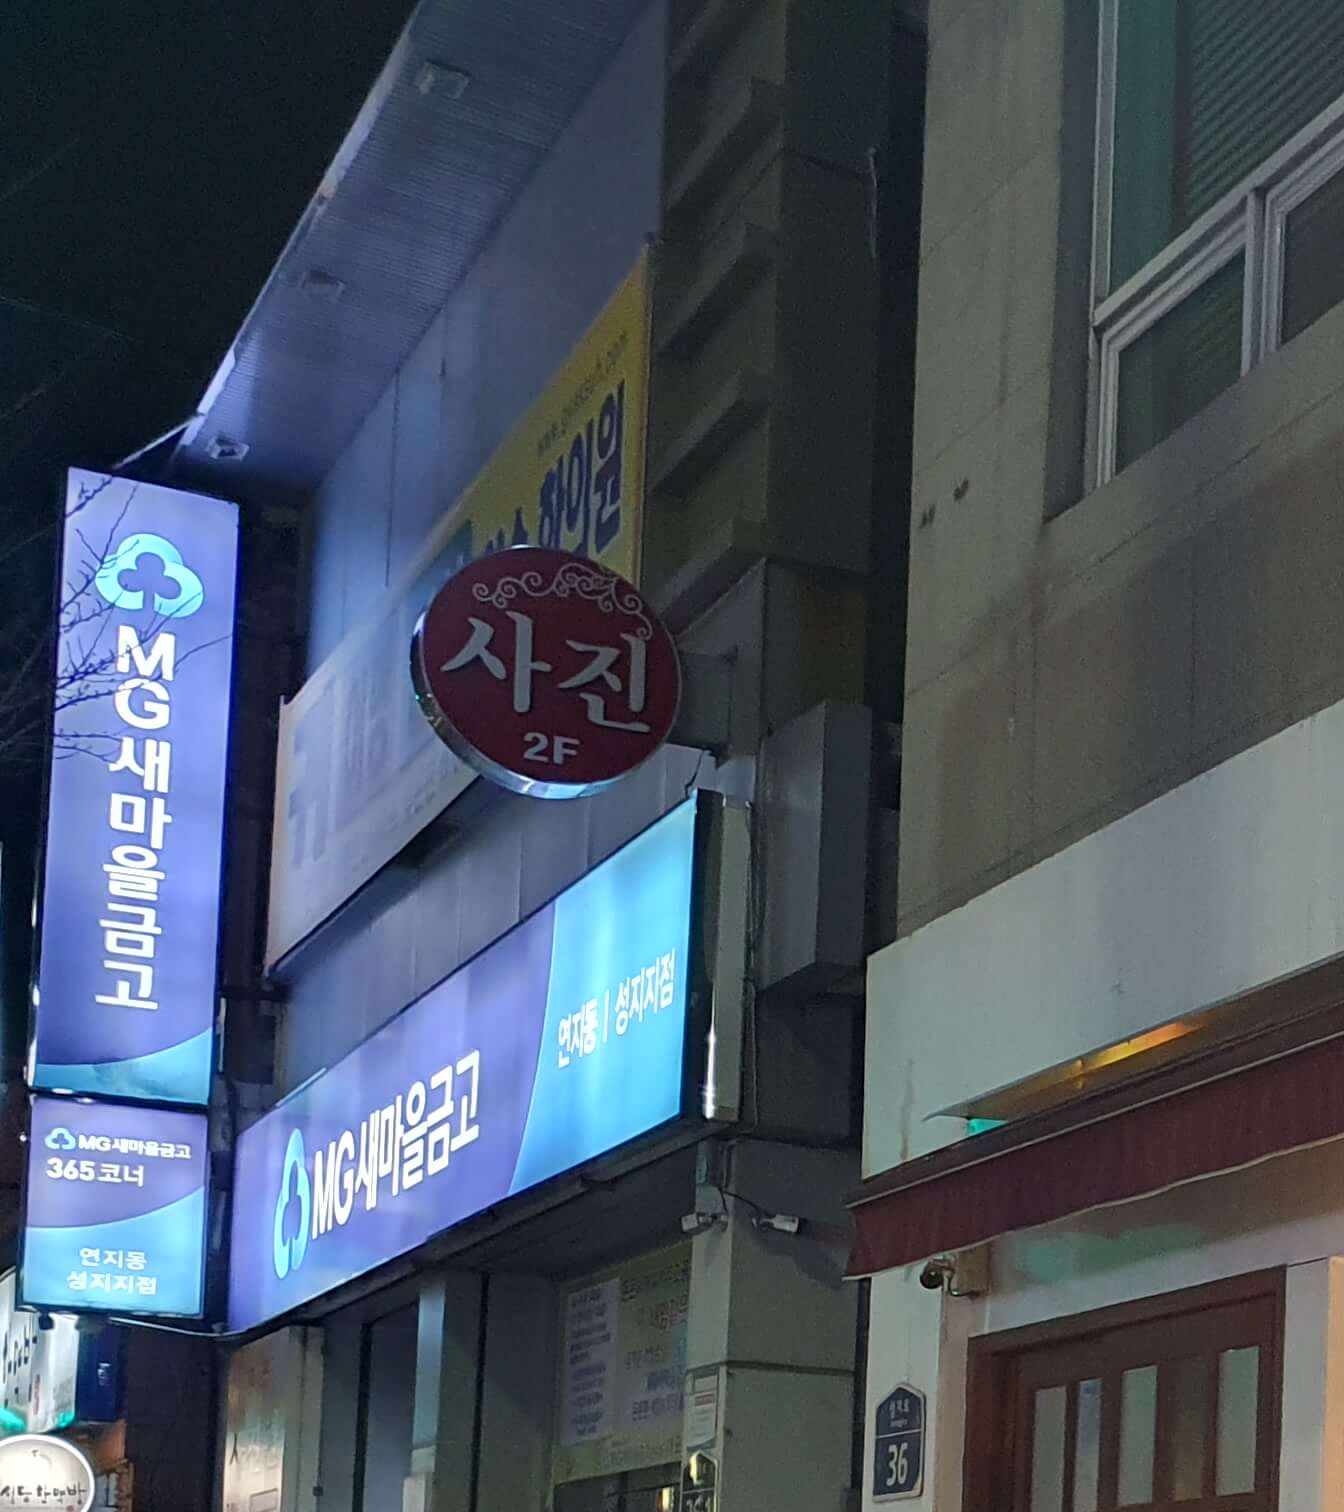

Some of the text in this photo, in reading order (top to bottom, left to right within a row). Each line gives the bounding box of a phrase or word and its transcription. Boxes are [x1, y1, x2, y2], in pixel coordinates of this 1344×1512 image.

[440, 611, 651, 733] 사진
[523, 732, 581, 765] 2F
[95, 624, 176, 1010] MG새마을금고
[558, 947, 677, 1069] 연지동 성지지점
[78, 1134, 192, 1159] MG새마을금고
[311, 1050, 480, 1241] MG새마을금고
[79, 1247, 147, 1270] 연지동
[66, 1271, 158, 1295] 성지지점
[886, 1442, 909, 1487] 36
